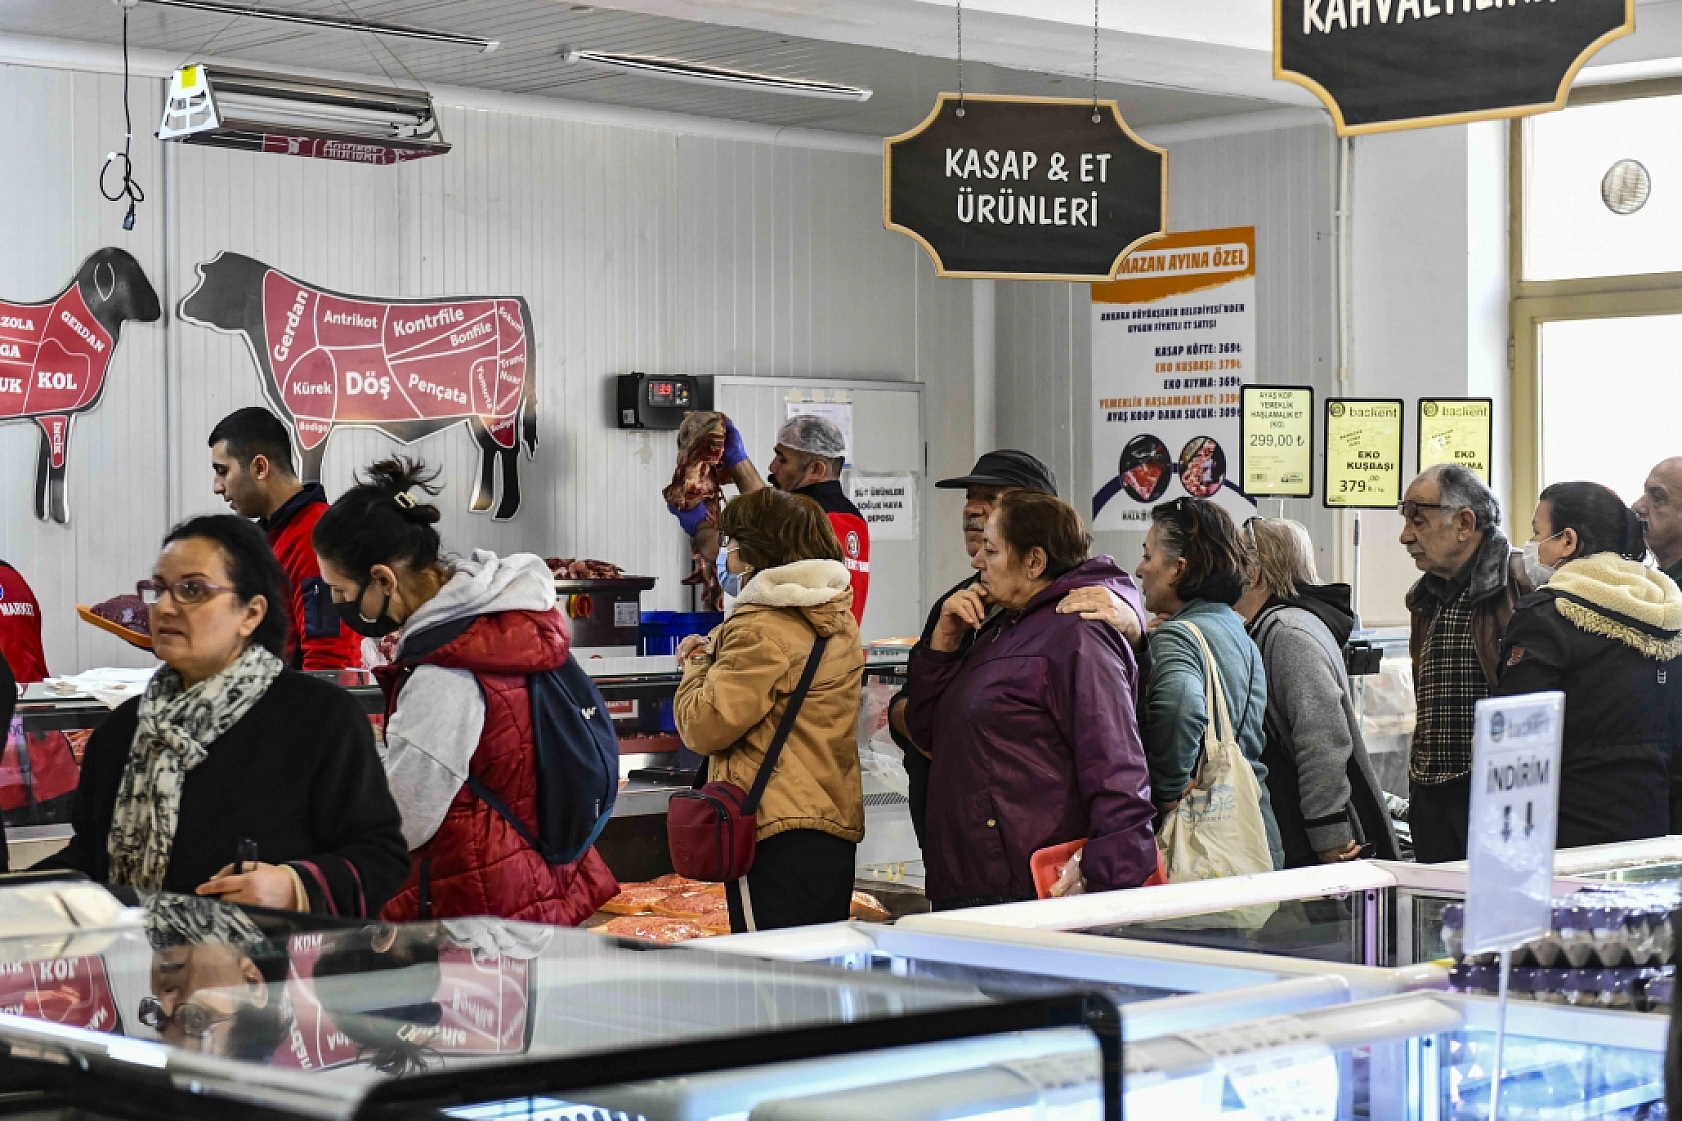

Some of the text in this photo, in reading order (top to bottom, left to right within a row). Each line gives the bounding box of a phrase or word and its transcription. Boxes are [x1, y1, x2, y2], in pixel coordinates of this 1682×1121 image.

[945, 148, 1112, 183] KASAP & ET
[957, 186, 1098, 227] ÜRÜNLERİ
[1168, 251, 1209, 271] AYINA
[1212, 247, 1245, 267] ÖZEL
[273, 290, 310, 362] Gerdan
[322, 309, 379, 330] Antrikot
[393, 306, 465, 338] Kontrfile
[60, 310, 106, 354] GERDAN
[449, 321, 493, 347] Bonfile
[1155, 346, 1184, 357] KASAP
[1187, 342, 1217, 355] KÖFTE:
[1155, 362, 1173, 373] EKO
[37, 371, 78, 390] KOL
[293, 381, 333, 395] Kürek
[345, 370, 390, 401] Döş
[408, 373, 468, 404] Pençata
[1164, 379, 1181, 389] EKO
[1157, 409, 1183, 420] DANA
[1250, 434, 1293, 447] 299,00
[1357, 450, 1381, 459] EKO
[1454, 450, 1476, 459] EKO
[1346, 461, 1394, 471] KUŞBAŞI
[1339, 479, 1366, 492] 379
